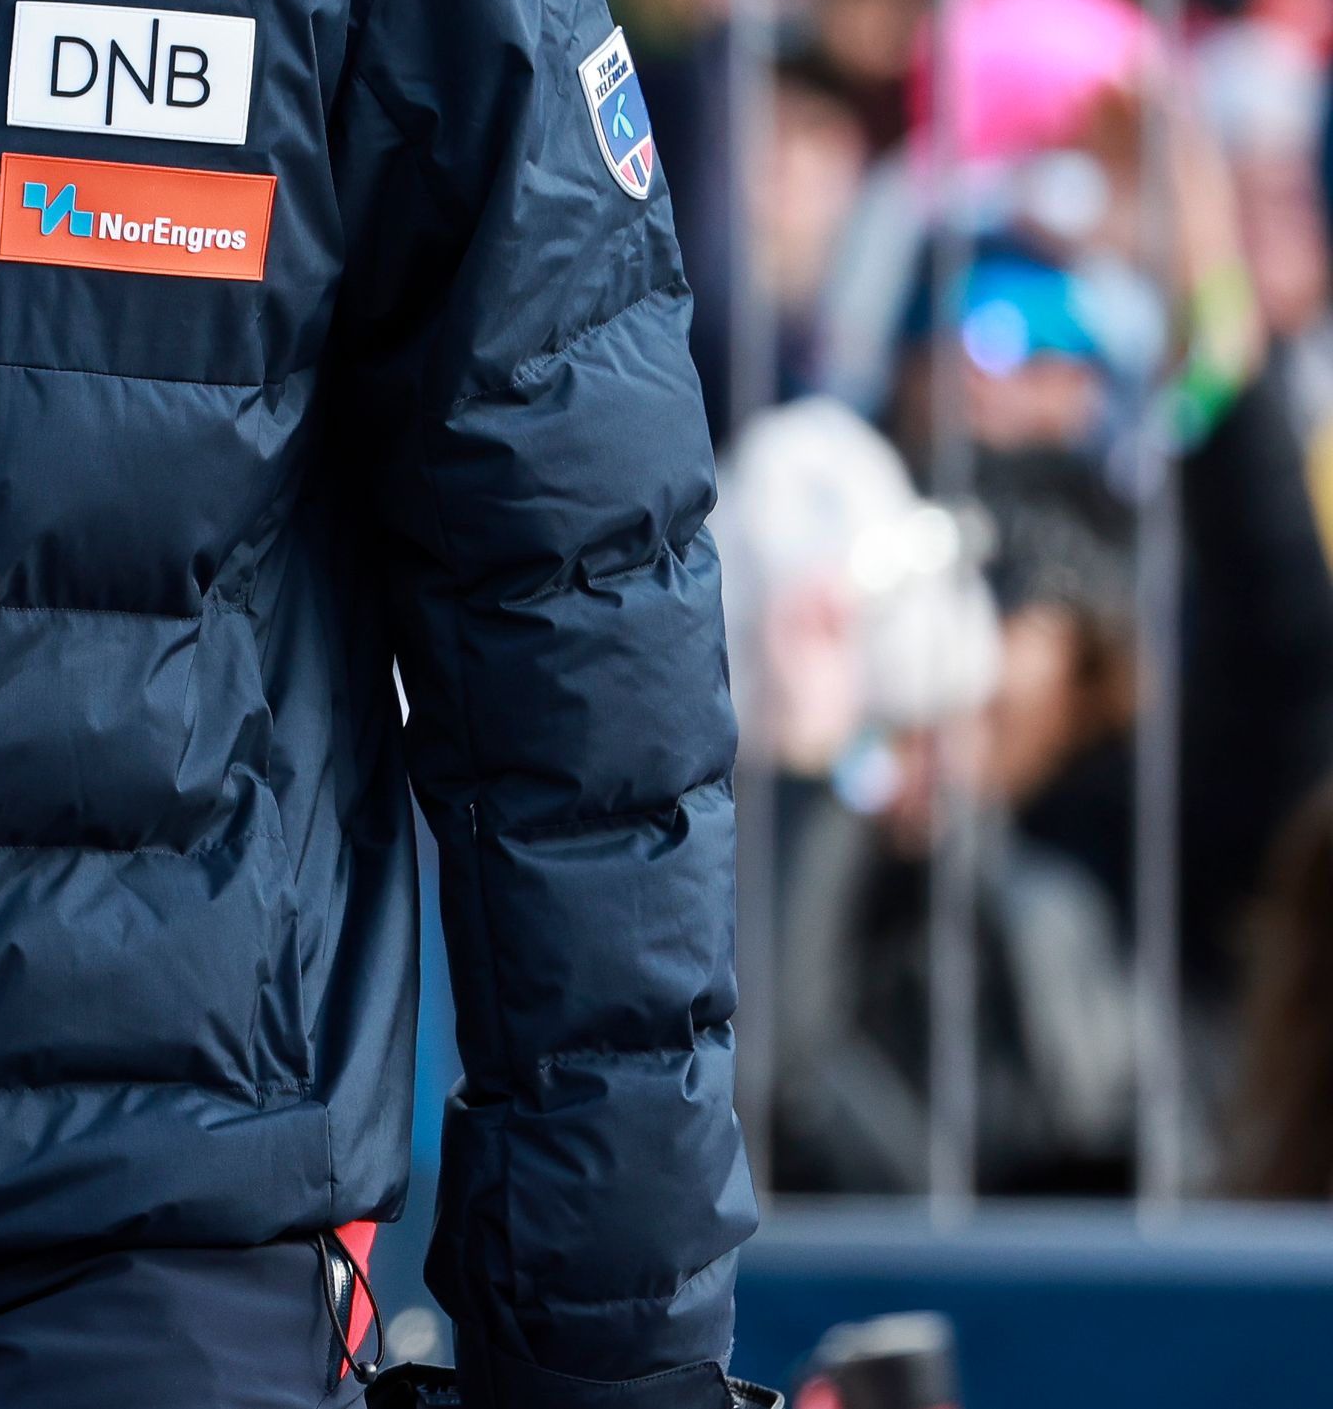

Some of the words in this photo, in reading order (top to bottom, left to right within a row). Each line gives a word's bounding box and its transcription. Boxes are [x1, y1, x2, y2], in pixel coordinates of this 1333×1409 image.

[49, 18, 211, 125] DNB
[595, 59, 629, 100] TELENOR
[597, 51, 619, 79] TEAM
[99, 212, 247, 252] NorEngros
